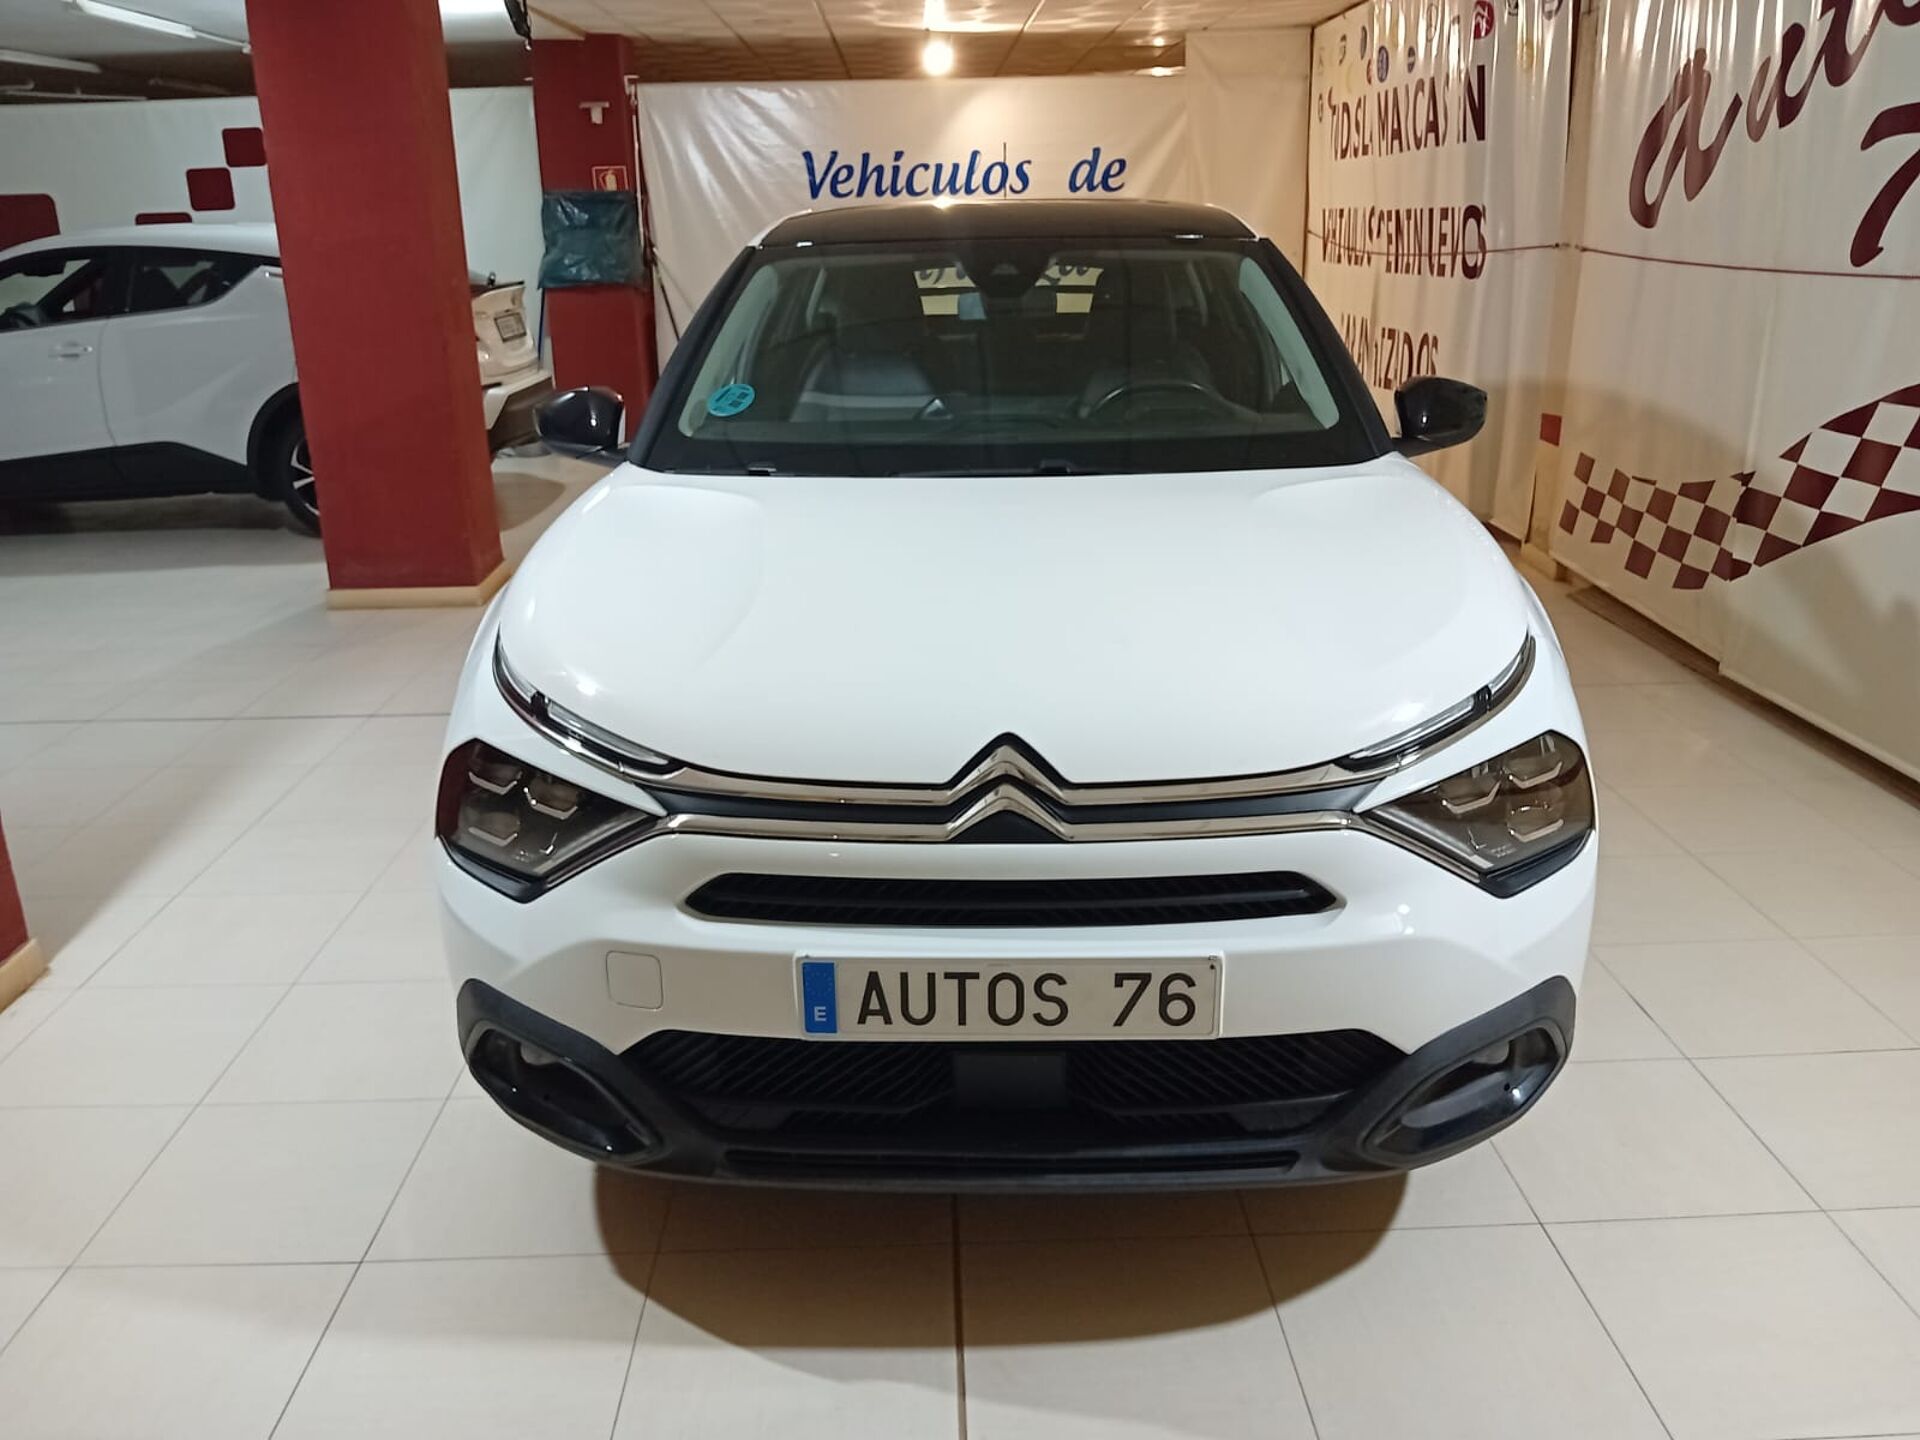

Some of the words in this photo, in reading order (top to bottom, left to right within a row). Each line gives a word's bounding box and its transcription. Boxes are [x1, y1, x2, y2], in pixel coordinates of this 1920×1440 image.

[1456, 64, 1486, 145] N
[1068, 147, 1127, 193] de
[814, 1006, 827, 1021] E
[857, 970, 1069, 1027] AUTOS
[1112, 972, 1197, 1027] 76
